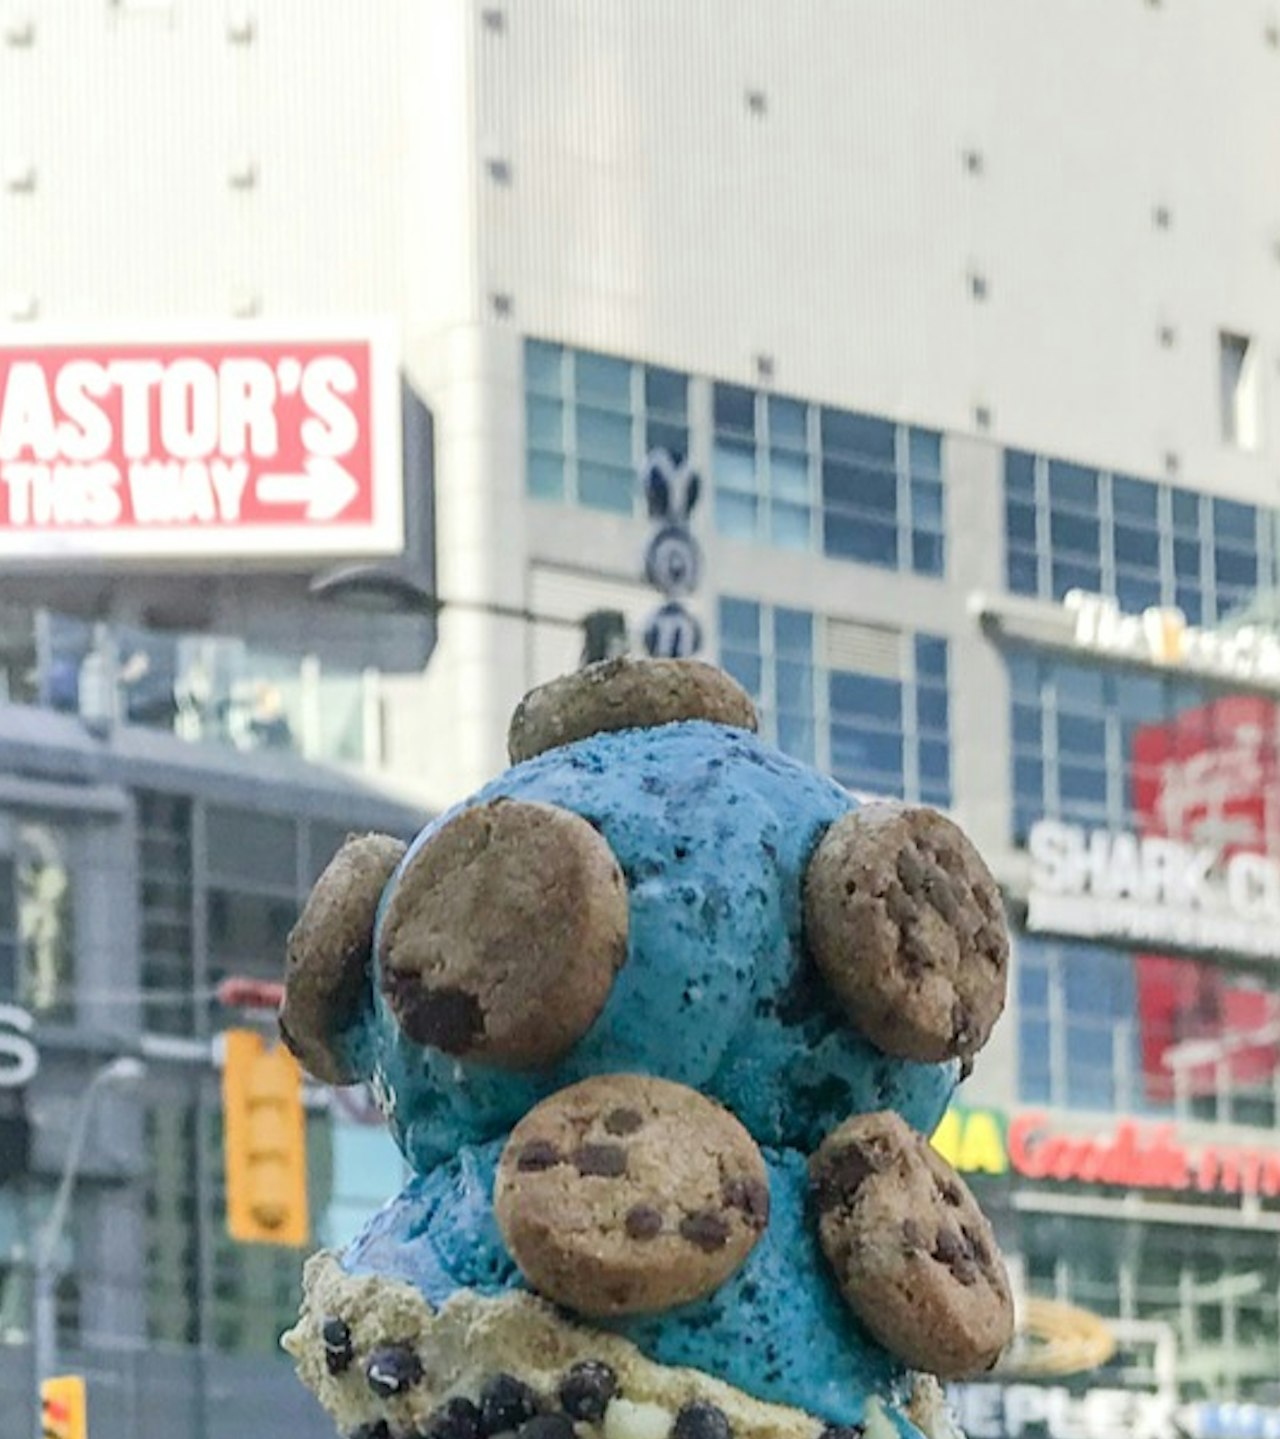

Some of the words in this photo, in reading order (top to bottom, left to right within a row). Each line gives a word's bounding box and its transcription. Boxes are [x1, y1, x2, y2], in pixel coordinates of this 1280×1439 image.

[0, 458, 121, 524] THIS
[127, 458, 251, 523] WAY
[1028, 819, 1220, 912] SHARK
